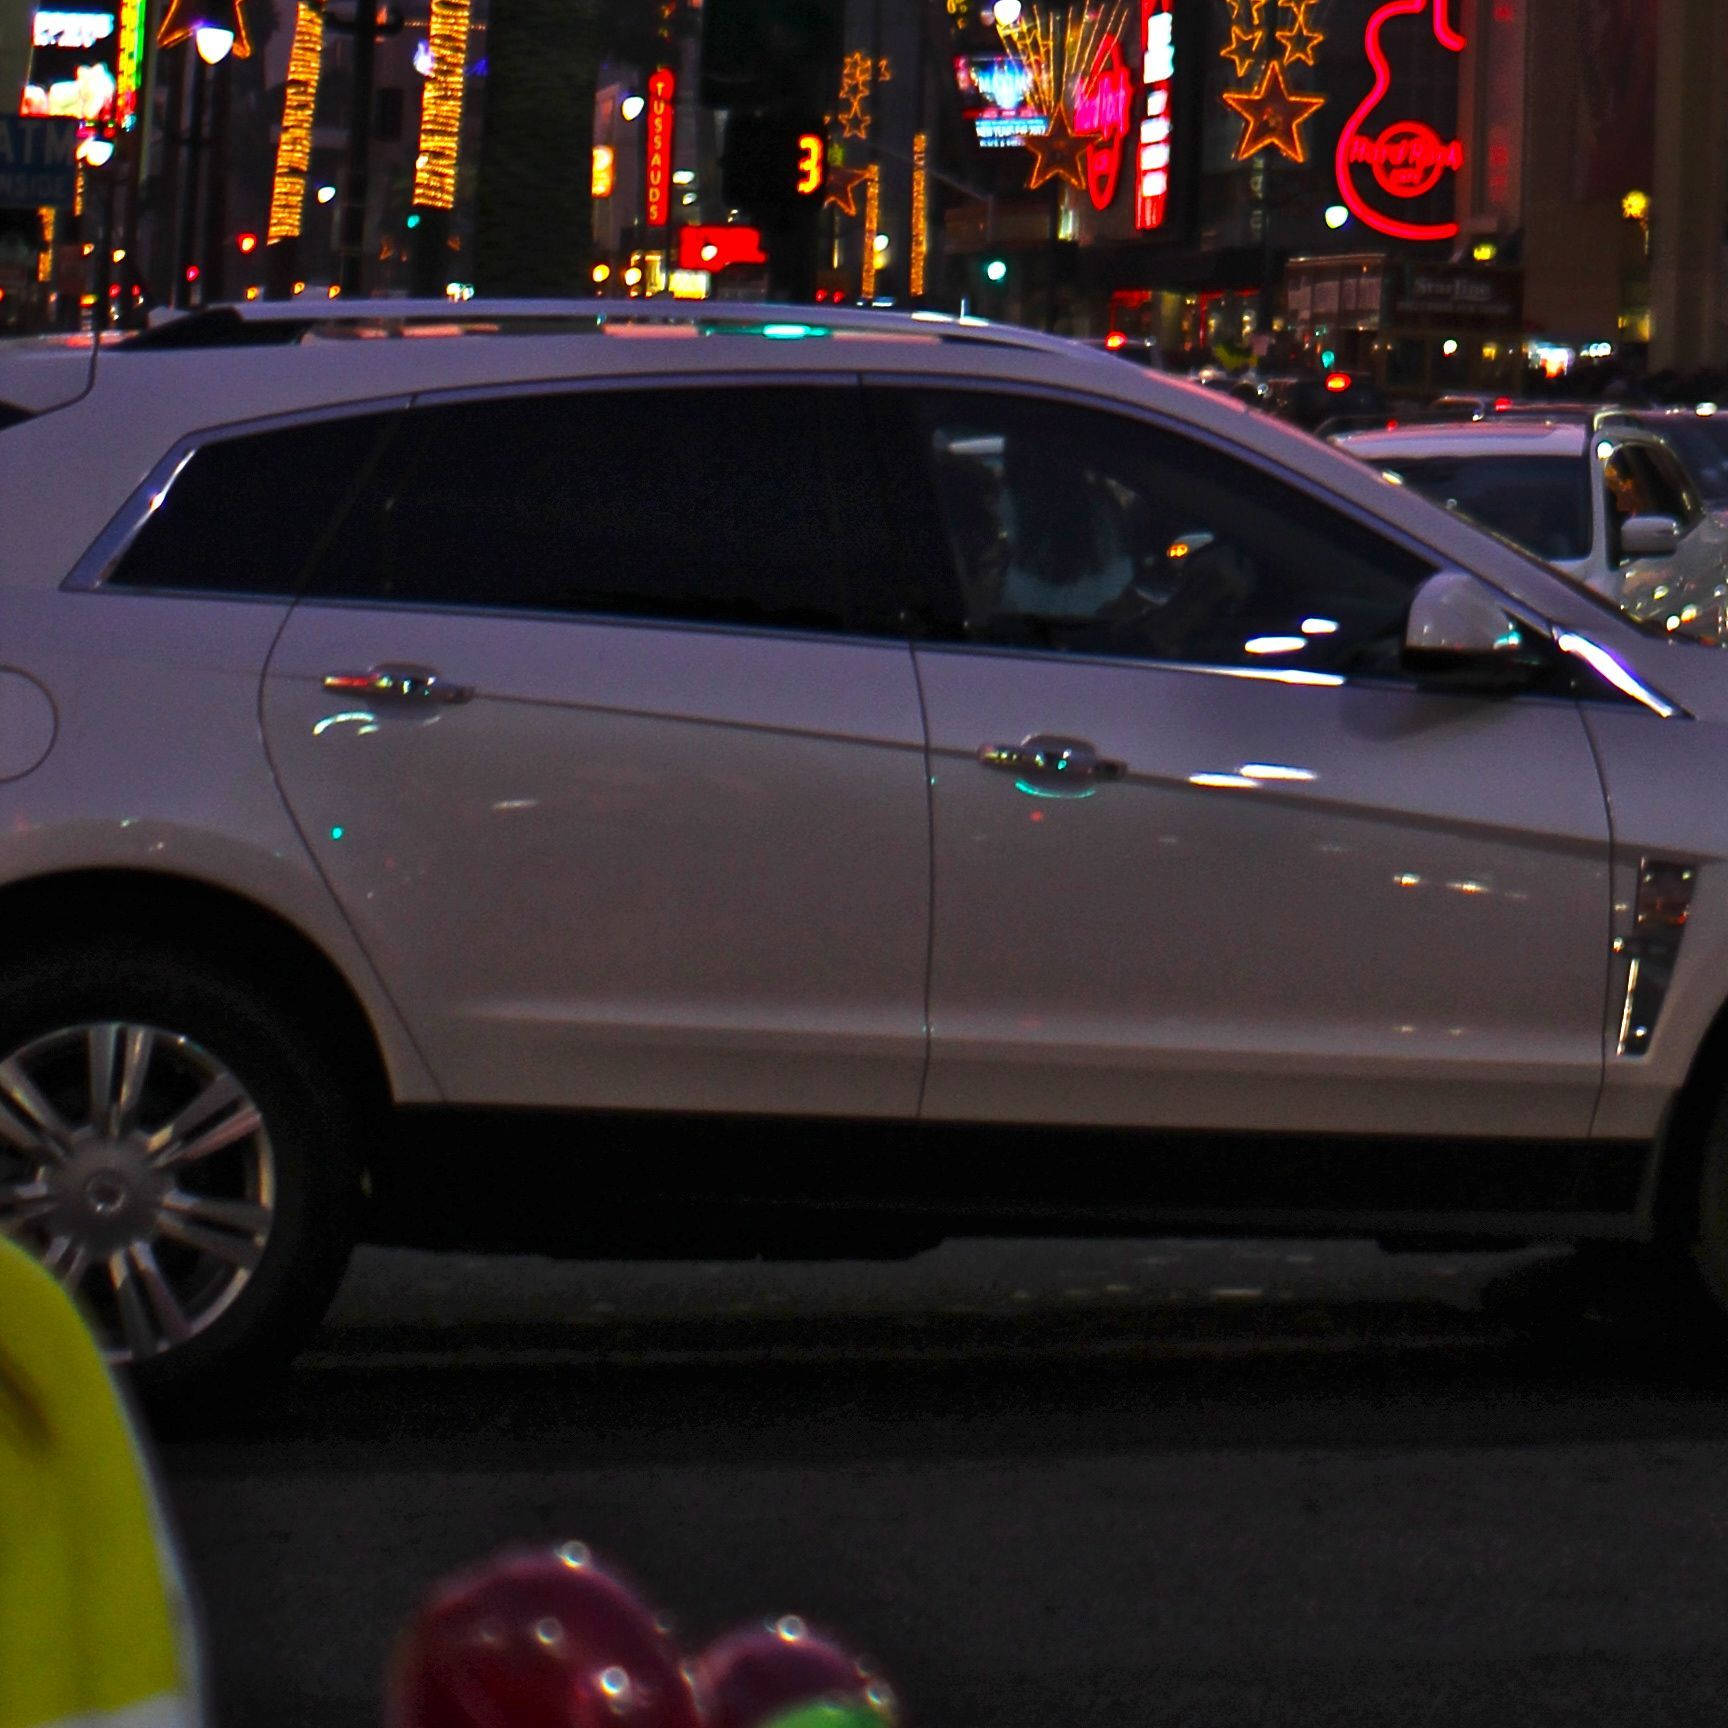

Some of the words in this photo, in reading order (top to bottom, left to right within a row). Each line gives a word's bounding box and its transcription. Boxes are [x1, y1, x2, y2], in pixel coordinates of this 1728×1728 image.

[0, 120, 73, 165] ATM
[647, 79, 665, 222] TUSSAUDS
[797, 132, 824, 197] 3
